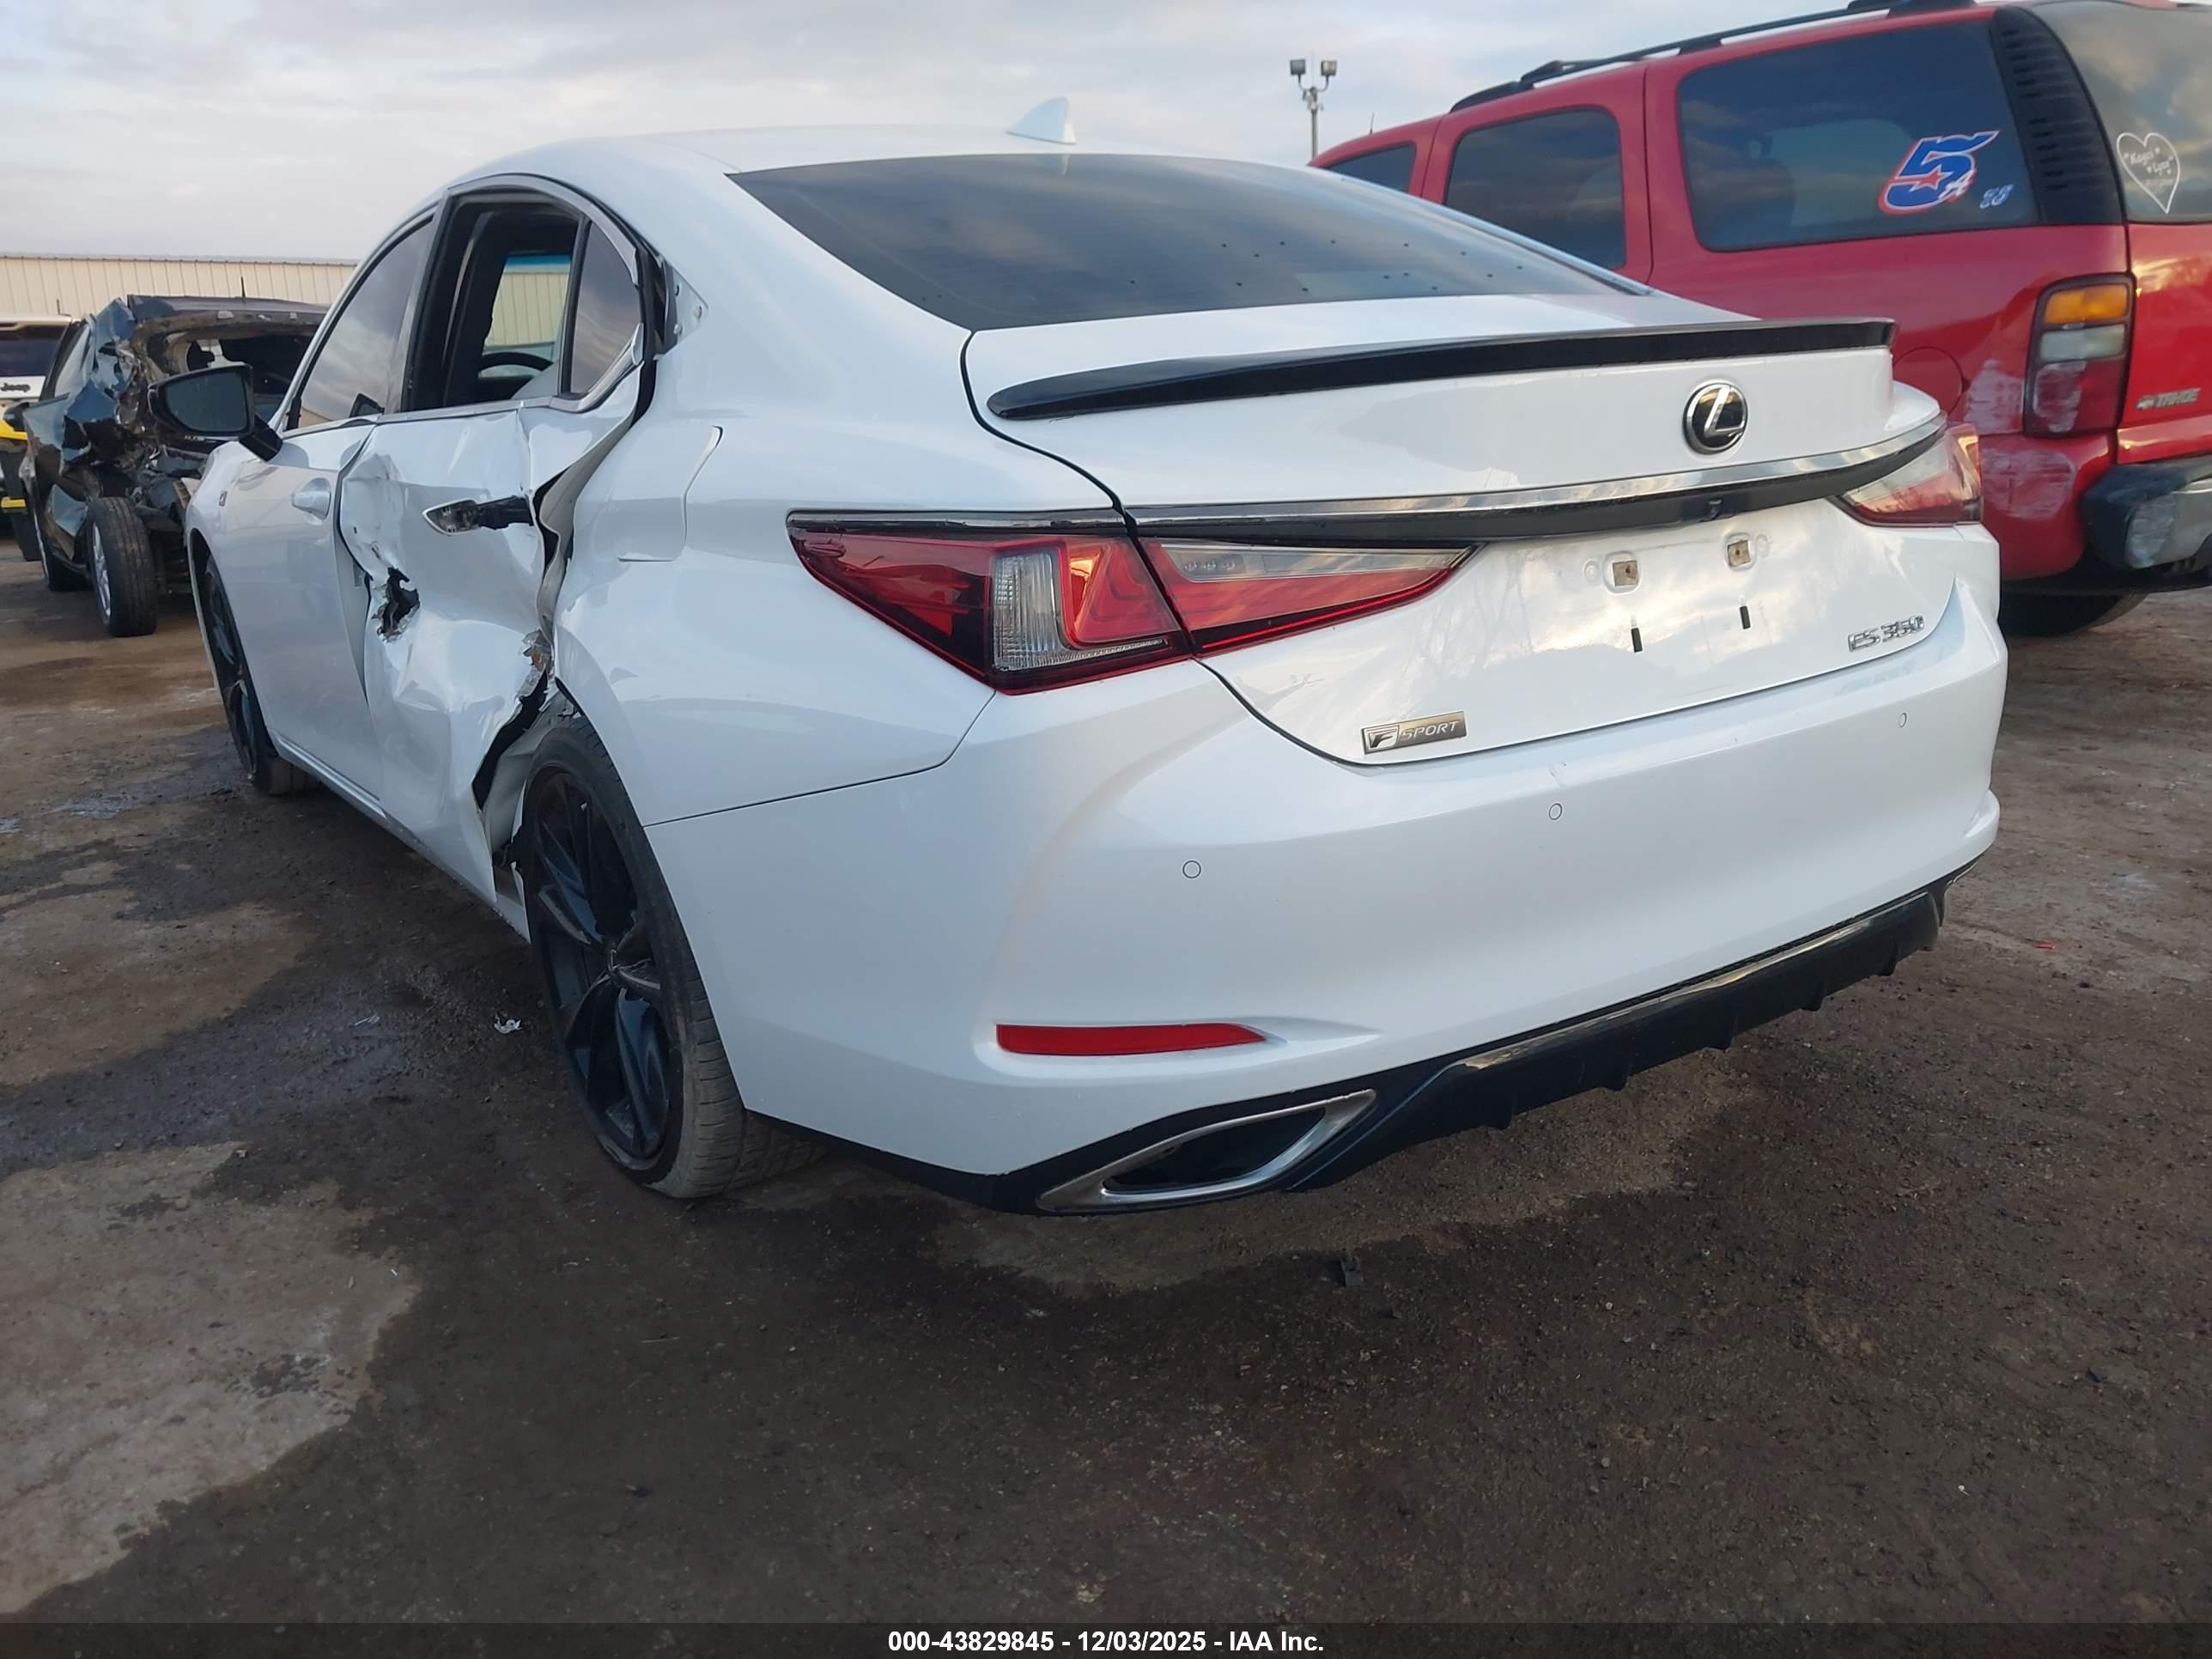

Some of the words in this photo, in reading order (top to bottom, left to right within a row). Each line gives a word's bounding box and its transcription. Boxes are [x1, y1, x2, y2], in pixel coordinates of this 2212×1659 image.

[1, 381, 31, 393] Jeep
[2154, 388, 2201, 408] TAHOE
[1848, 628, 1881, 653] ES
[1881, 616, 1924, 642] 350
[1367, 728, 1397, 749] F
[1401, 720, 1459, 739] SPORT
